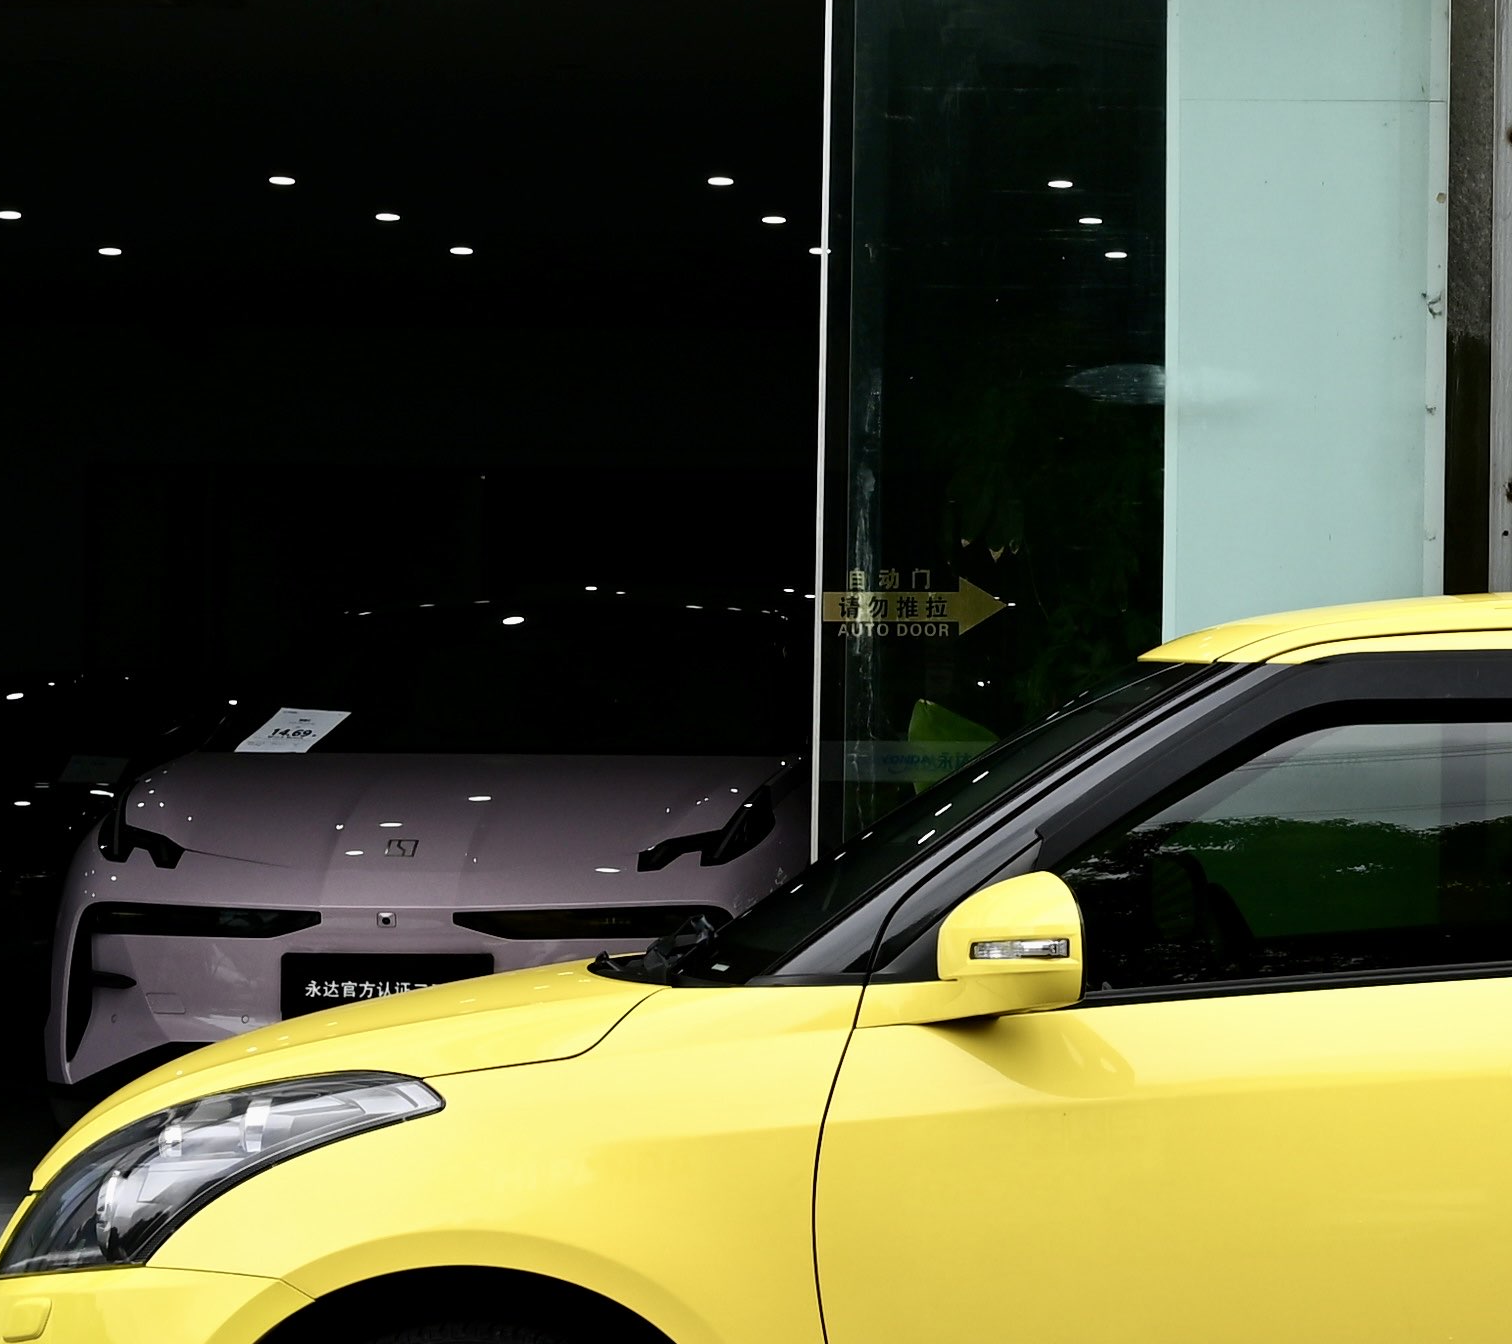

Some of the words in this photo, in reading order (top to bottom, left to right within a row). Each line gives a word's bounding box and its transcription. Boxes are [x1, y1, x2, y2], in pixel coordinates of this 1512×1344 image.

[849, 567, 931, 590] 自动门
[838, 596, 948, 619] 请勿推拉
[838, 623, 889, 637] AUTO
[897, 623, 949, 637] DOOR
[304, 980, 443, 998] 永达官方认证
